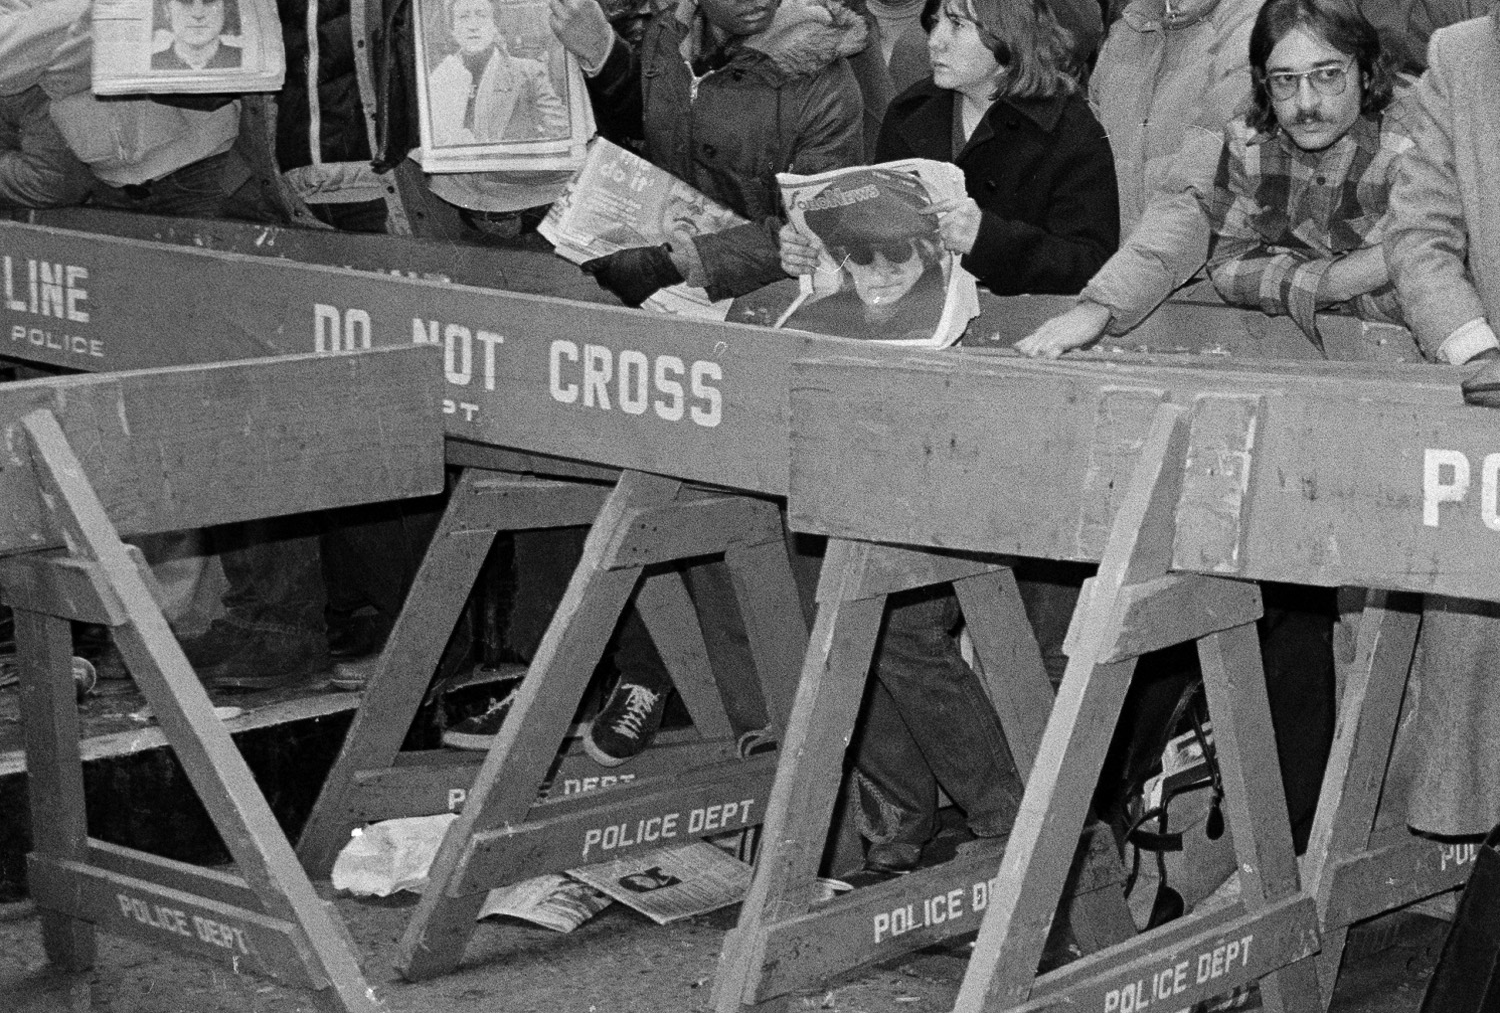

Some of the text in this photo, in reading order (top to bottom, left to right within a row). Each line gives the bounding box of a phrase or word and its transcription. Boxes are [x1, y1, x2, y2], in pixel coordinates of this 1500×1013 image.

[4, 255, 90, 323] LINE
[11, 325, 104, 357] POLICE
[549, 339, 723, 428] CROSS
[583, 799, 754, 860] POLICE DEPT
[117, 893, 248, 955] POLICE DEPT
[874, 888, 964, 944] POLICE
[1104, 934, 1254, 1013] POLICE DEPT
